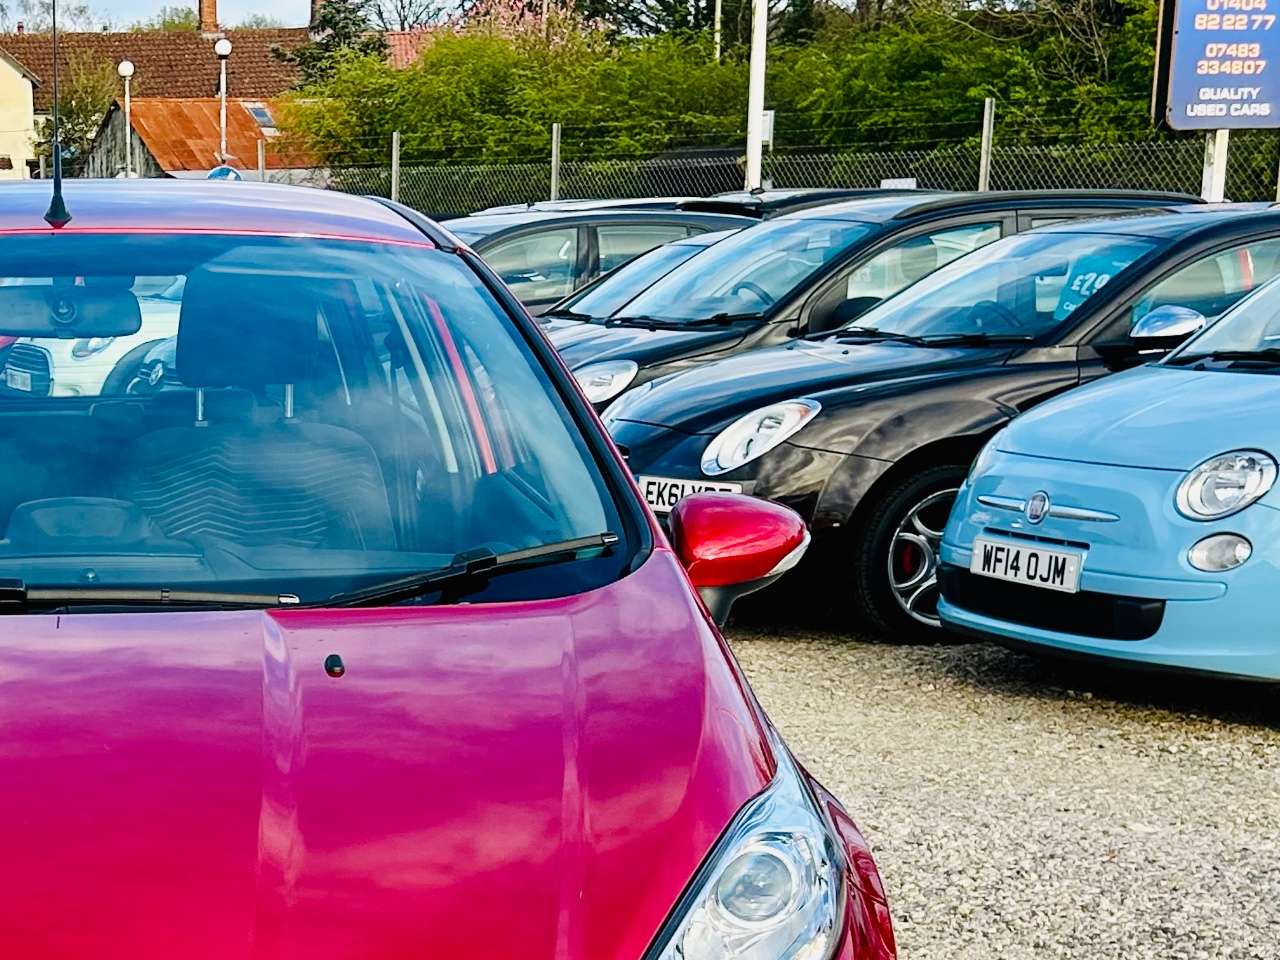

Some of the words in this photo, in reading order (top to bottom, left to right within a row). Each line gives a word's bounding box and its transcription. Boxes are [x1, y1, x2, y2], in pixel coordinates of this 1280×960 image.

[1199, 87, 1261, 100] QUALITY
[1186, 104, 1227, 117] USED
[1230, 103, 1271, 116] CARS
[982, 543, 1021, 578] WF14
[1026, 552, 1067, 586] OJM
